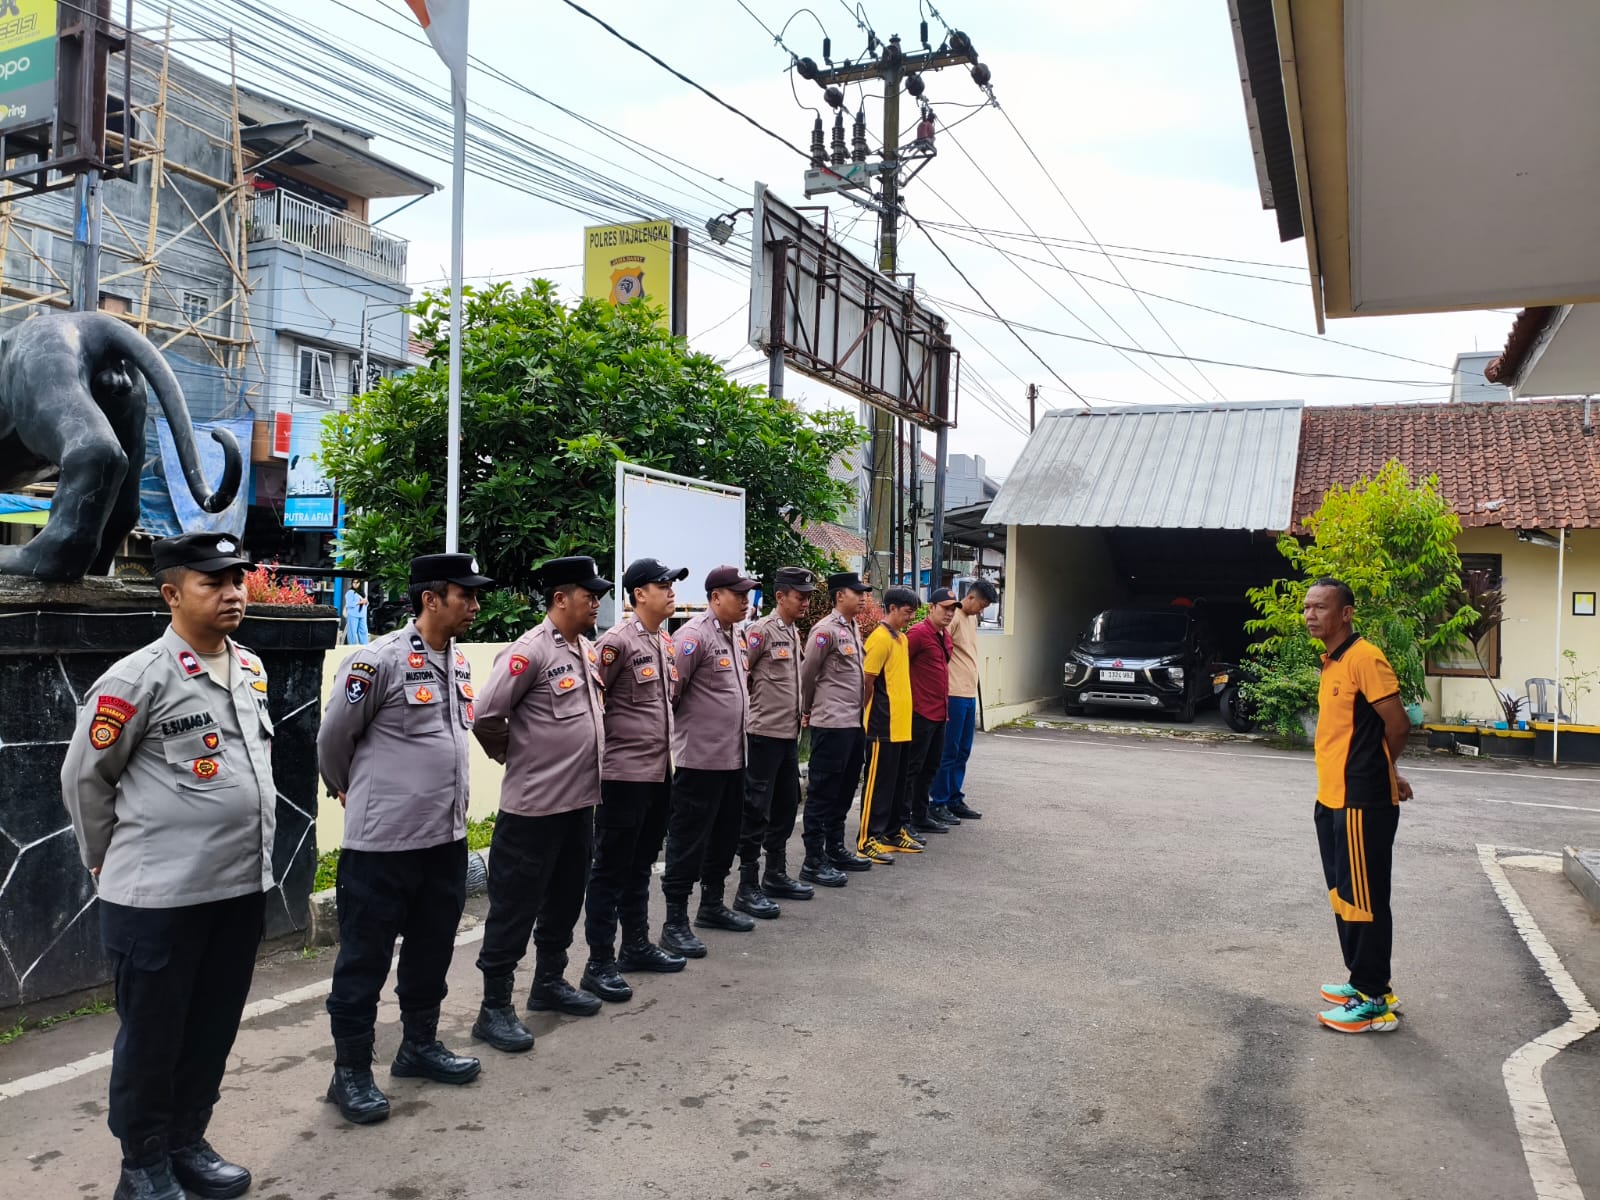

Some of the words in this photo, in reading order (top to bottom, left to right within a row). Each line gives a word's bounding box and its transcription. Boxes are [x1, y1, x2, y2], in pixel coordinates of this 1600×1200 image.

[589, 230, 617, 248] POLRES
[619, 225, 668, 245] MAJALENGKA
[284, 512, 309, 522] PUTRA
